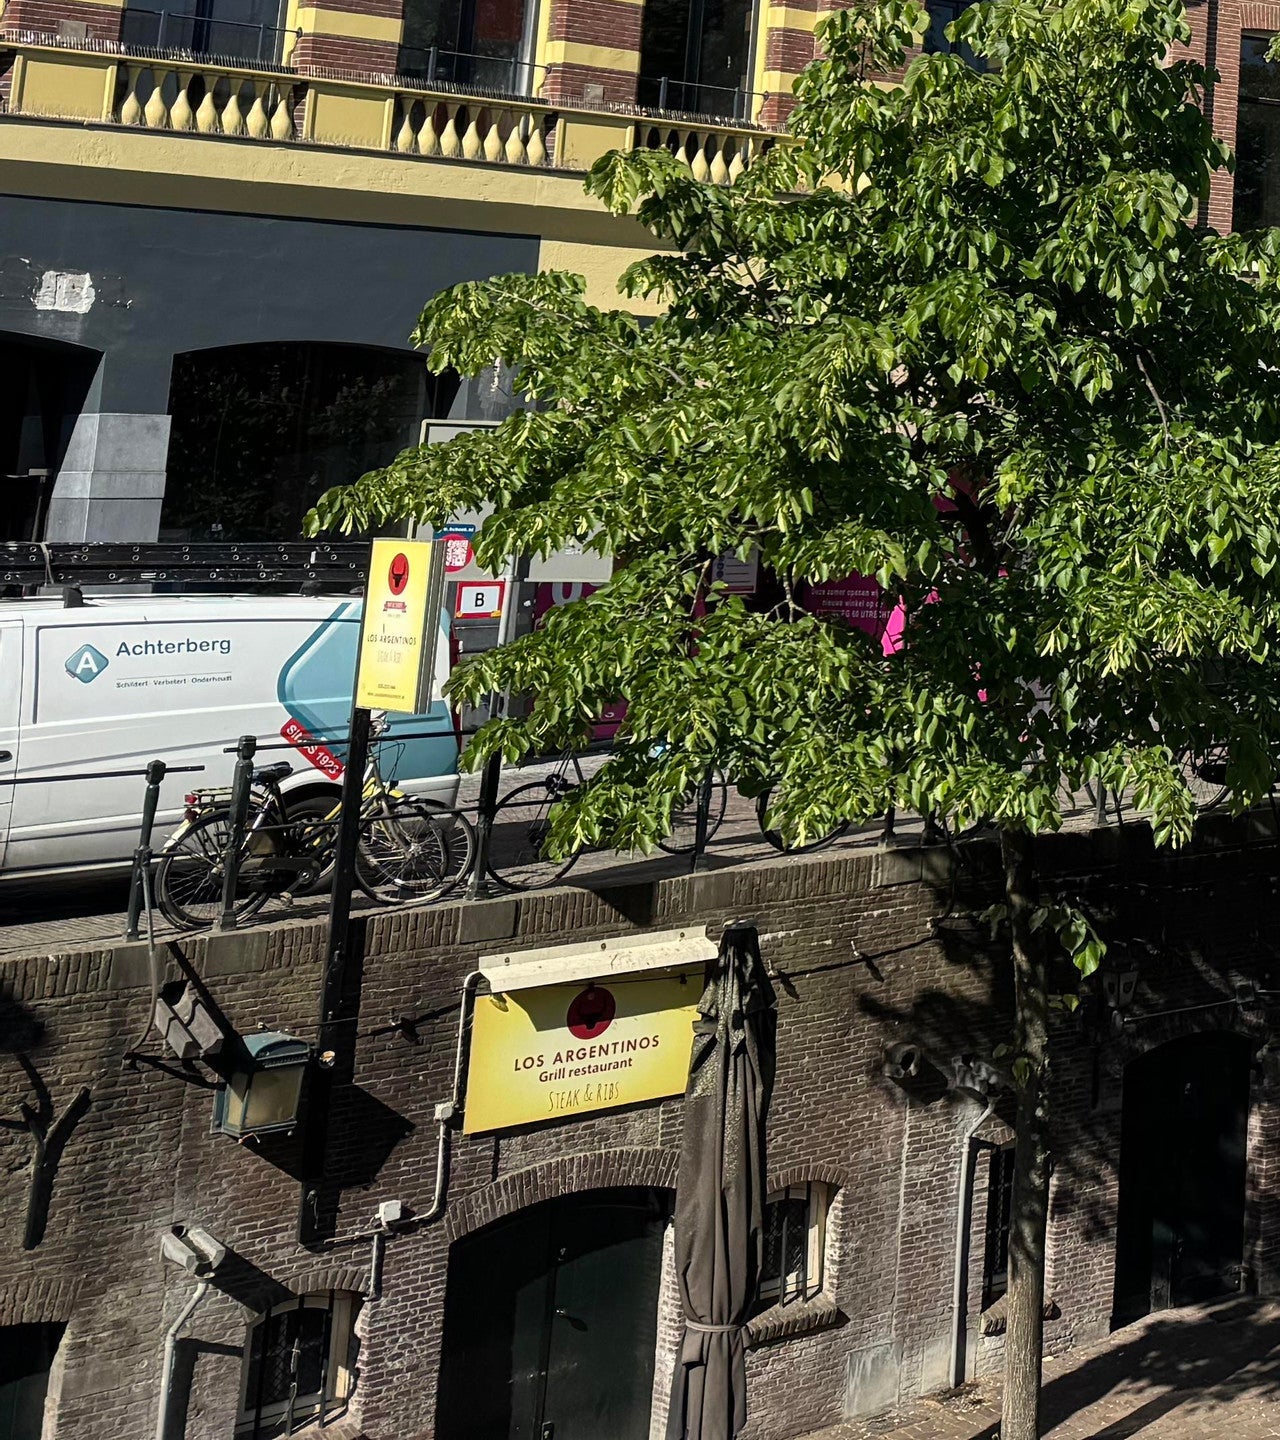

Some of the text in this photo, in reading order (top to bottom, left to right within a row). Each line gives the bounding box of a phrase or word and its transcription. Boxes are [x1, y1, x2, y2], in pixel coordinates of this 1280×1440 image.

[475, 592, 485, 607] B
[116, 638, 232, 657] Achterberg
[367, 634, 417, 646] LOS ARGENTINOS
[316, 752, 340, 775] 1923
[514, 1034, 660, 1072] LOS ARGENTINOS
[538, 1057, 633, 1083] Grill restaurant
[548, 1081, 620, 1112] STEAK & RIBS
